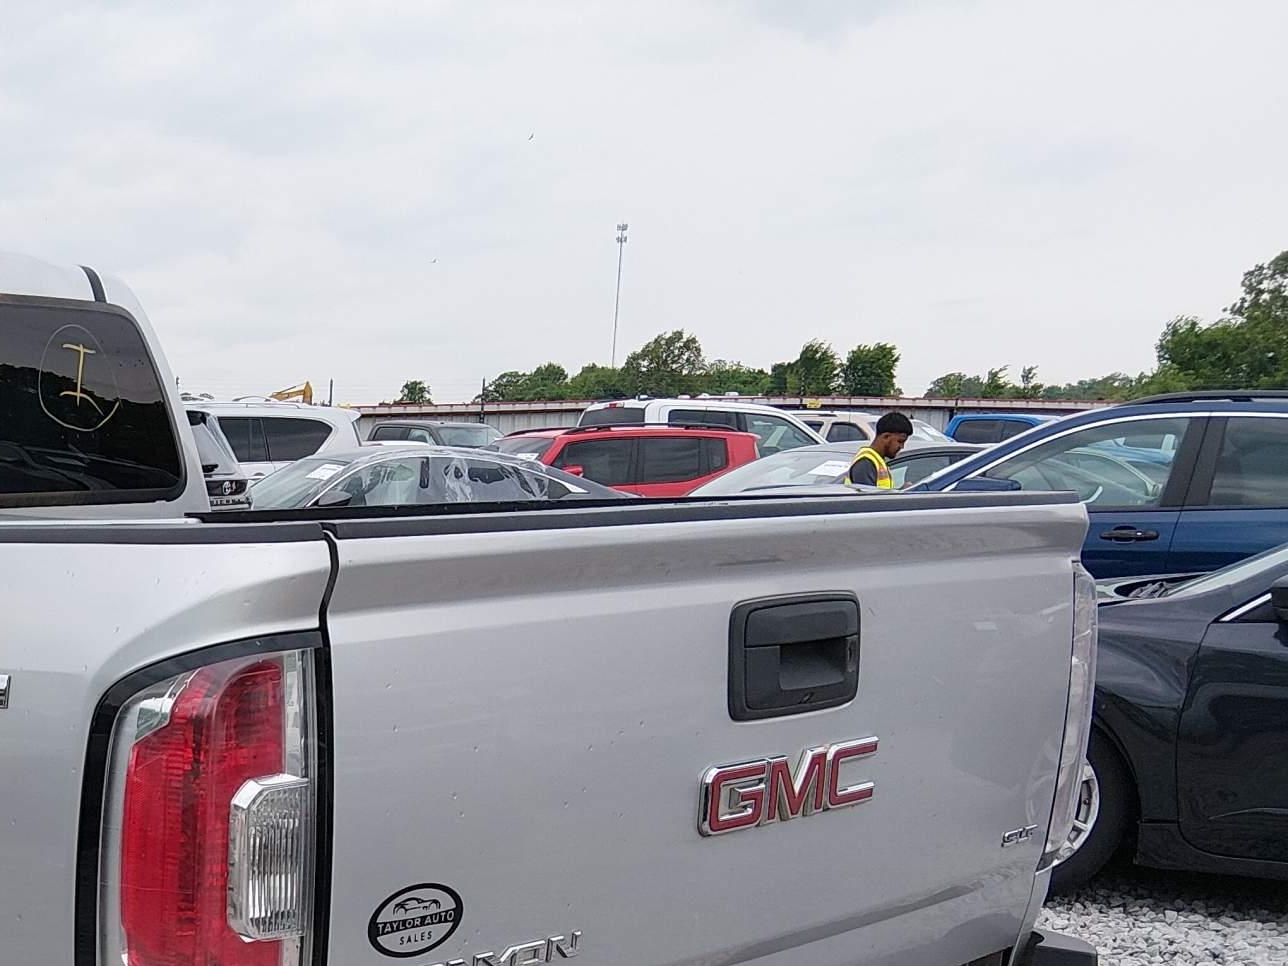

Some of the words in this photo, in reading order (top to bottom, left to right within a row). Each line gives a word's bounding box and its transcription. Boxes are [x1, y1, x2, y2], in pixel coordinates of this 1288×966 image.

[697, 735, 880, 837] GMC
[377, 917, 422, 935] TAYLOR
[424, 910, 455, 925] AUTO
[399, 930, 433, 946] SALES
